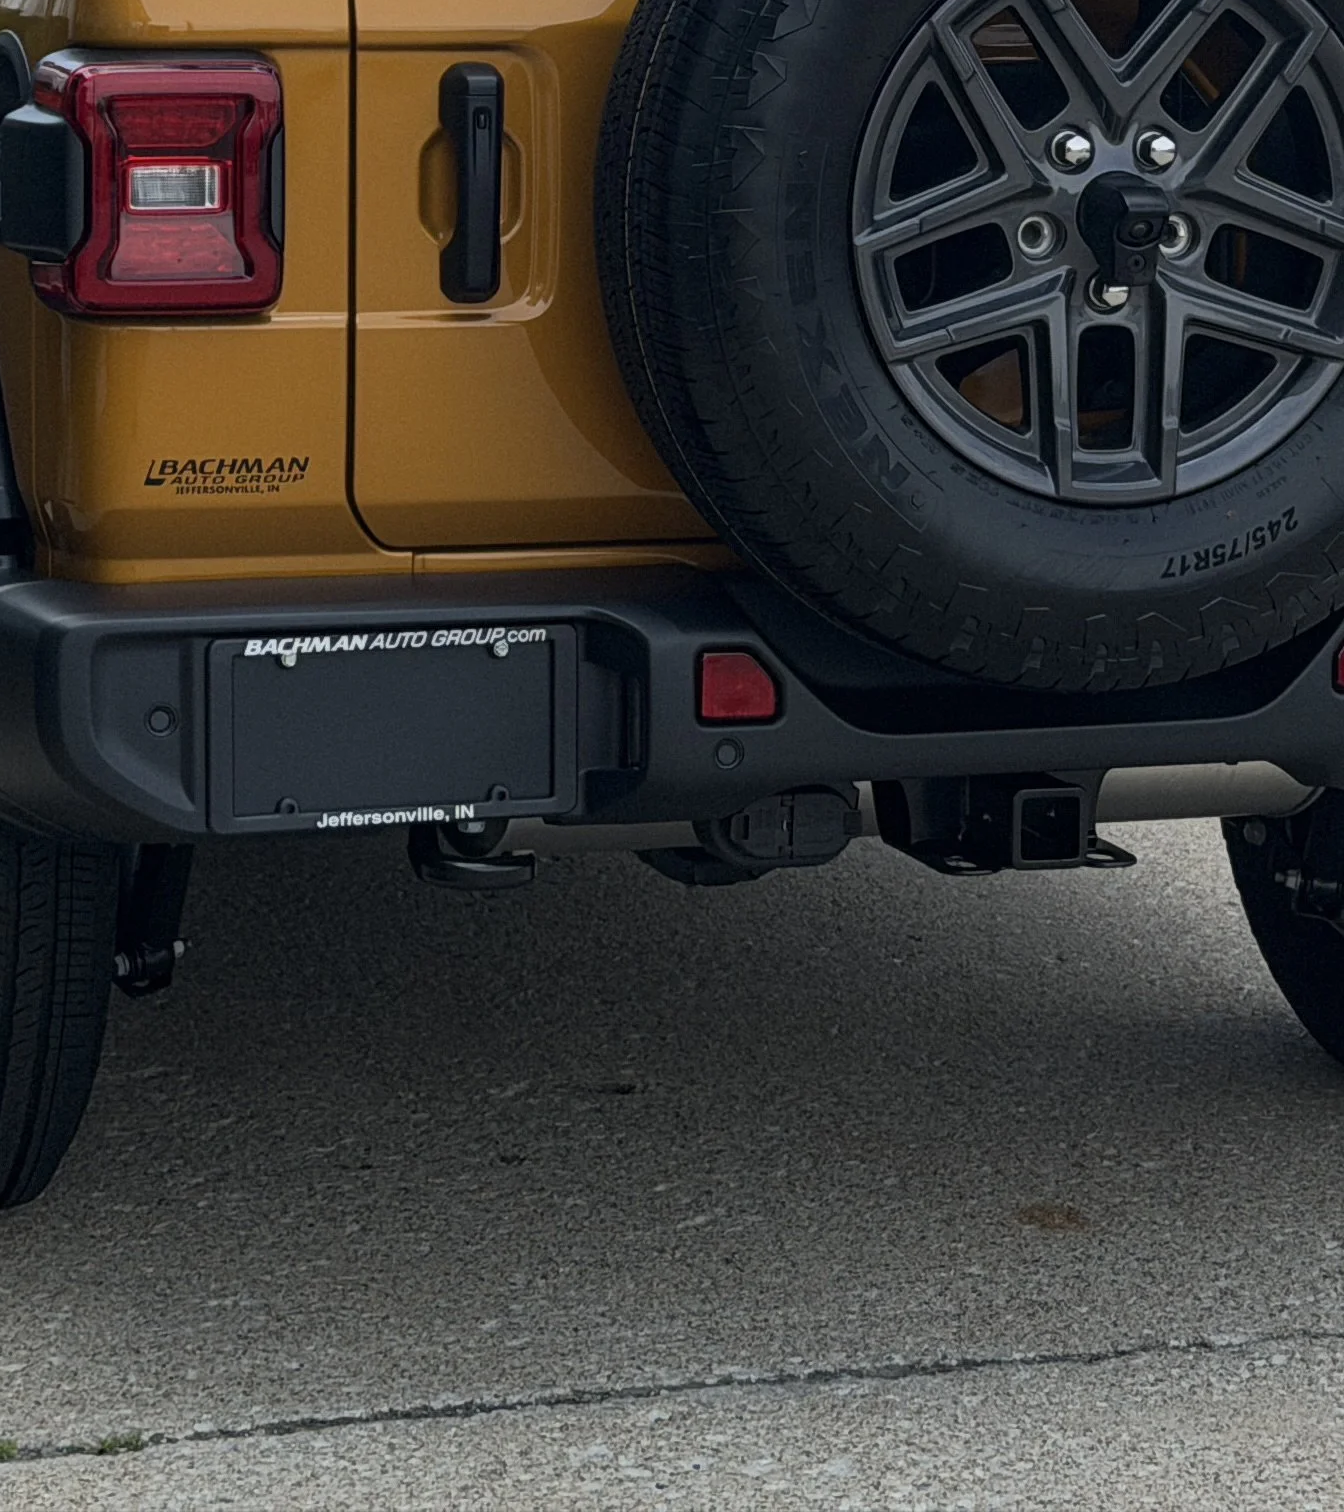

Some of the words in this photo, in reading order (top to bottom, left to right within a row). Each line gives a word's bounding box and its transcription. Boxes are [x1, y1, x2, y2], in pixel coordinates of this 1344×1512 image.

[159, 456, 310, 476] BACHMAN
[170, 475, 226, 486] AUTO
[234, 473, 306, 484] GROUP
[175, 485, 265, 495] JEFFERSONVILLE,
[267, 484, 281, 494] IN
[1160, 506, 1299, 579] 245/75R17
[244, 634, 369, 656] BACHMAN
[369, 631, 427, 649] AUTO
[317, 806, 450, 828] Jeffersonville,
[455, 803, 475, 820] IN
